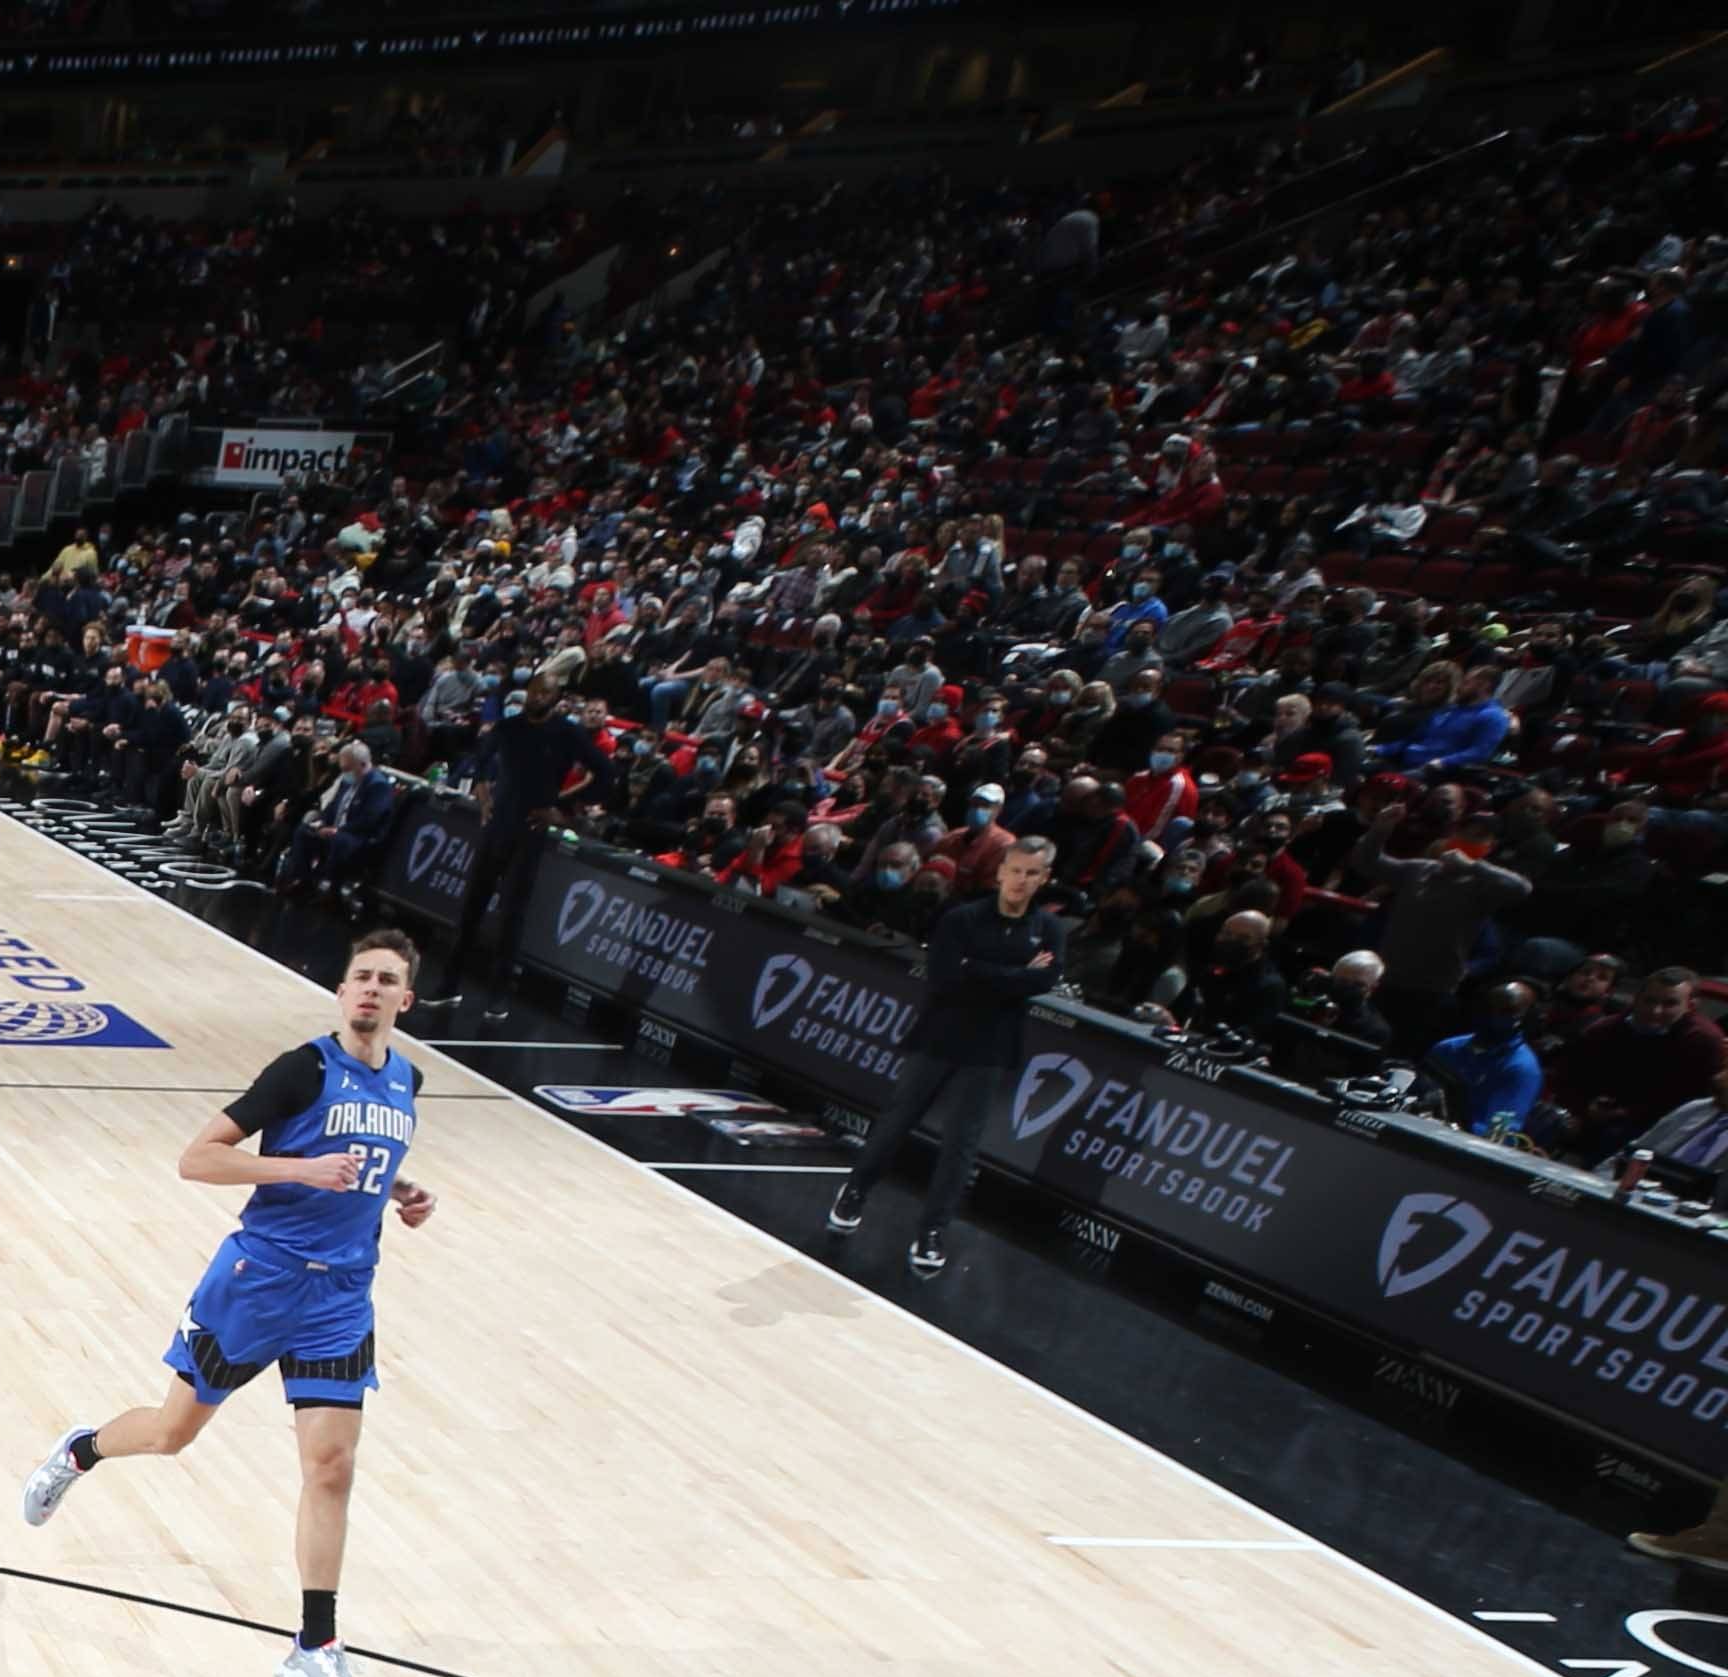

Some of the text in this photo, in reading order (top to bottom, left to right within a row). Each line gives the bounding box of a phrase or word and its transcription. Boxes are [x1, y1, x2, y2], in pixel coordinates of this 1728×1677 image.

[585, 935, 701, 994] SPORTSBOOK
[599, 895, 716, 967] FANDUEL
[324, 1101, 415, 1147] ORLANDO
[1084, 1080, 1296, 1198] FANDUEL
[1064, 1129, 1273, 1234] SPORTSBOOK
[1453, 1289, 1728, 1430] SPORTSBOO
